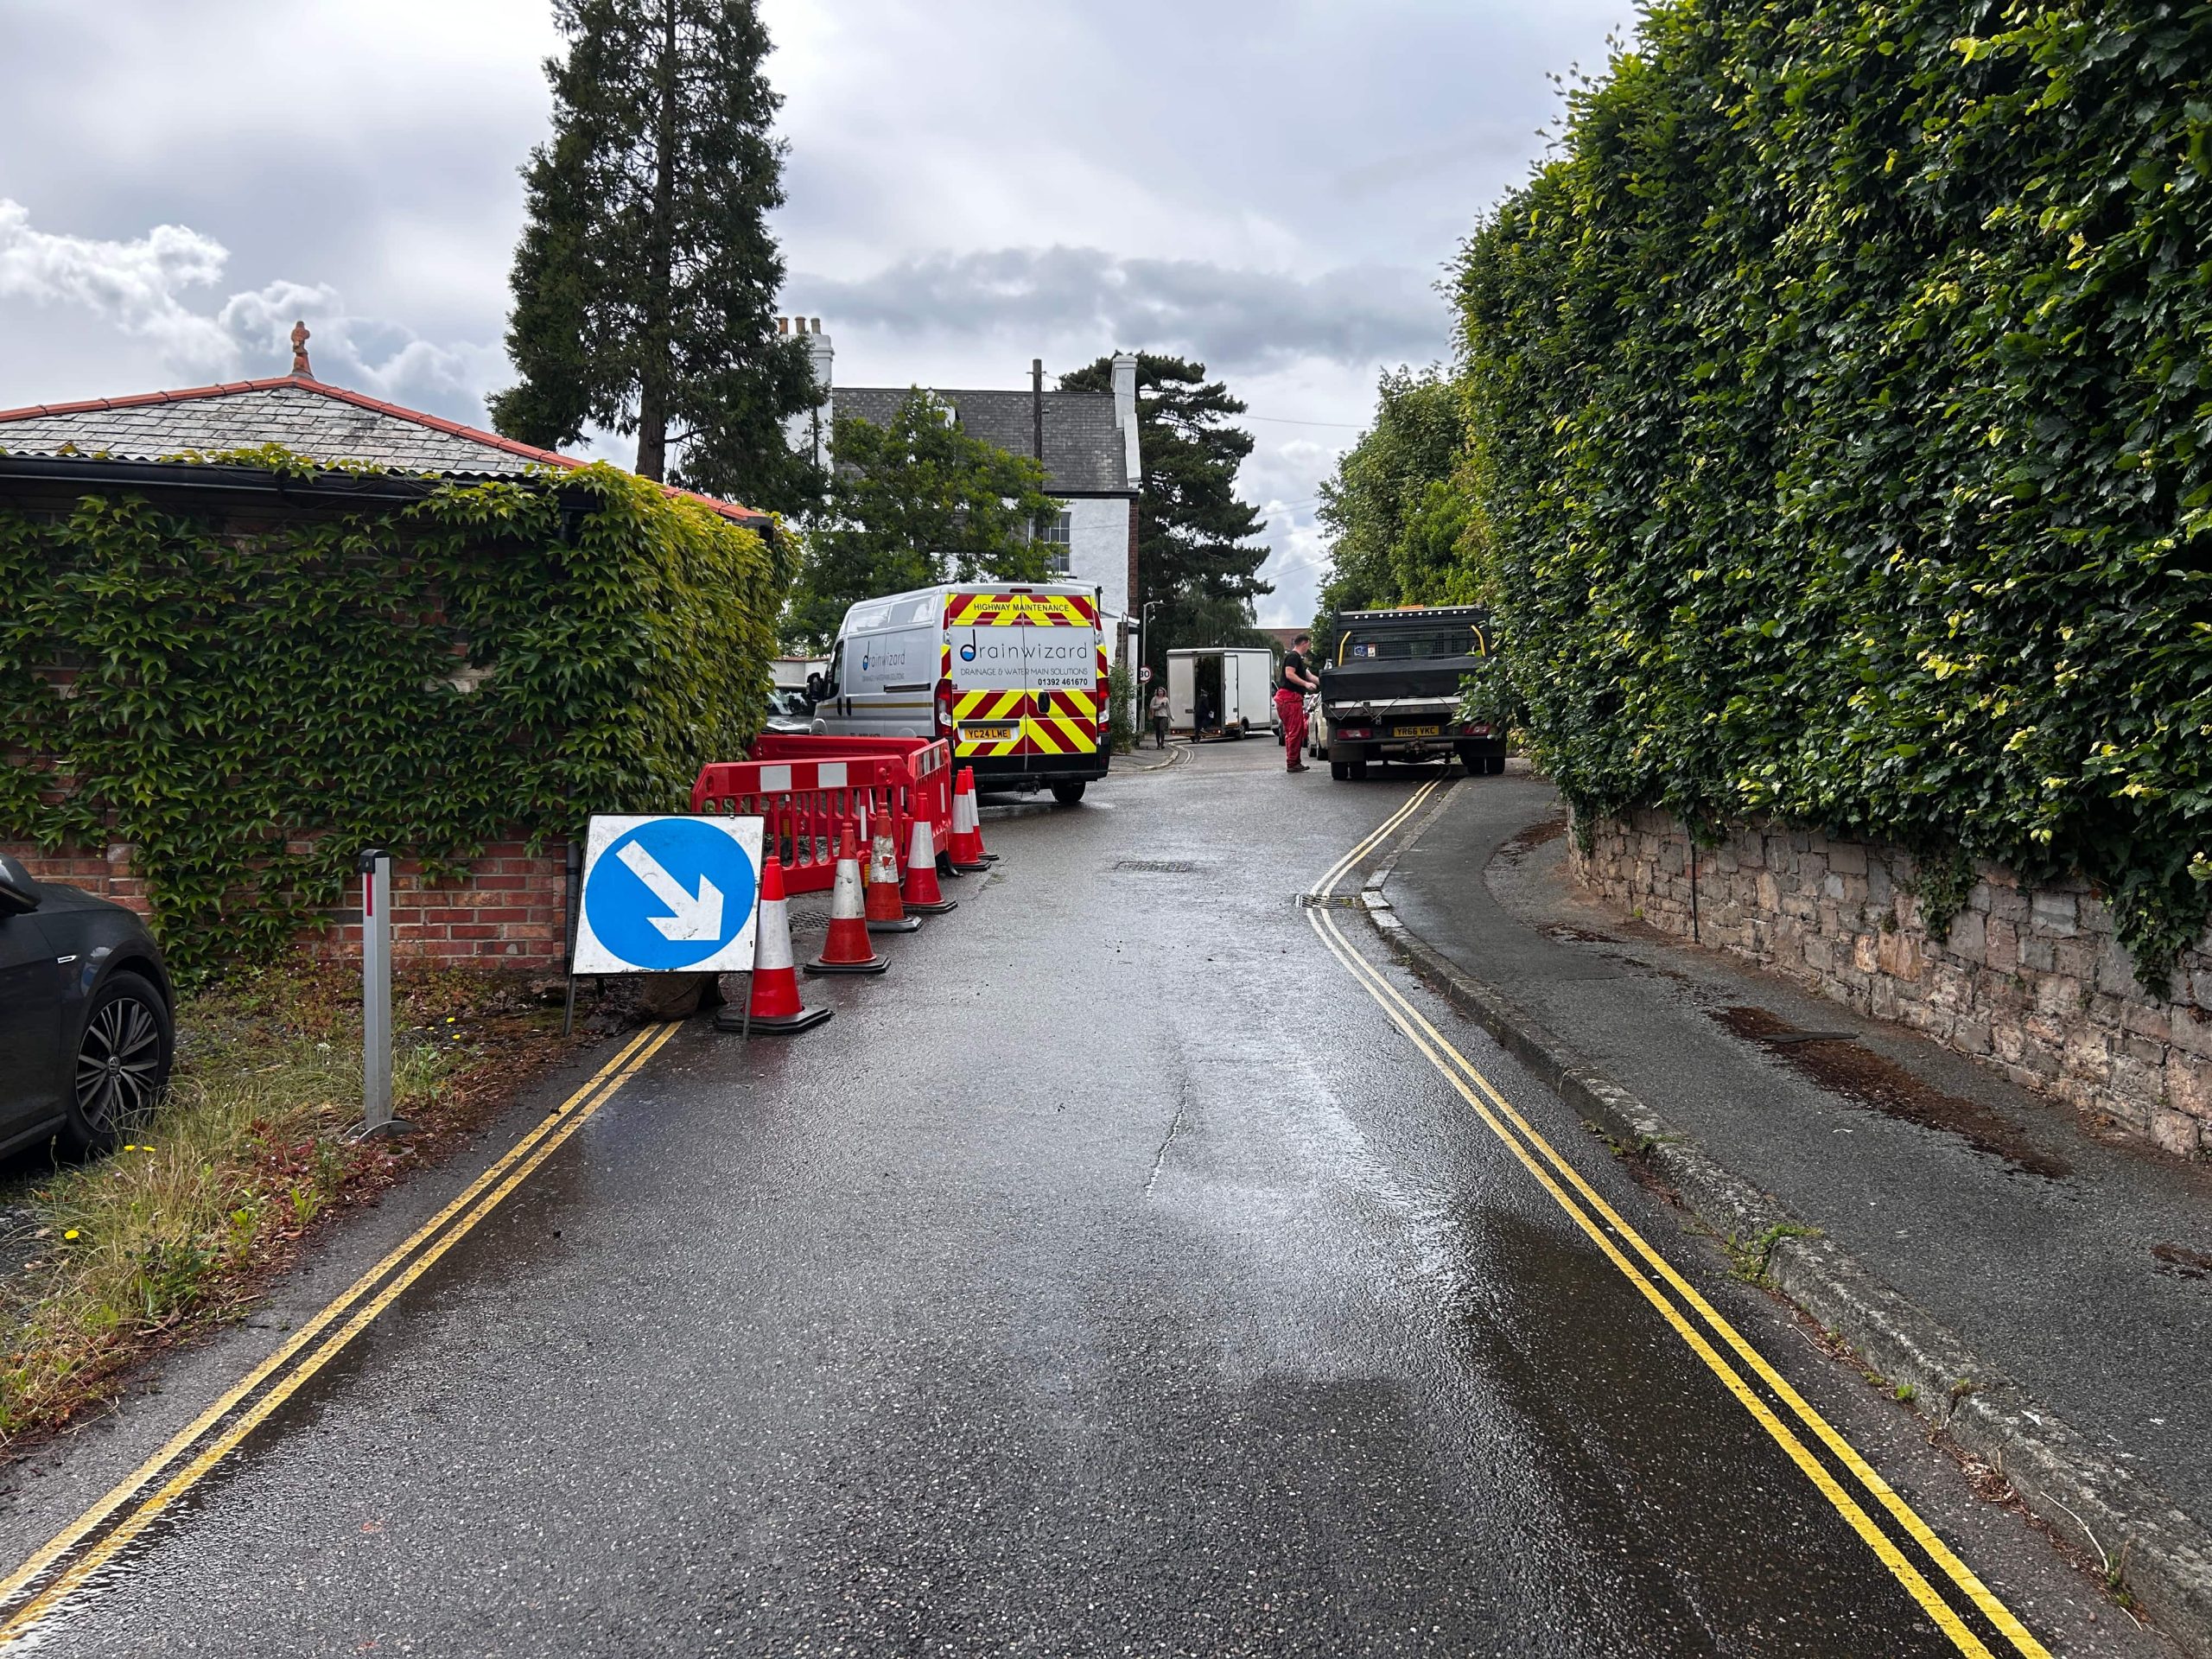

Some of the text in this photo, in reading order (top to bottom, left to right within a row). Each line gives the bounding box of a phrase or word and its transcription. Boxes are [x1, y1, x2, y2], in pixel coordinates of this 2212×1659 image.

[960, 629, 1087, 662] drainwizard
[968, 729, 1007, 738] YC24 LME
[1397, 727, 1418, 735] YR66
